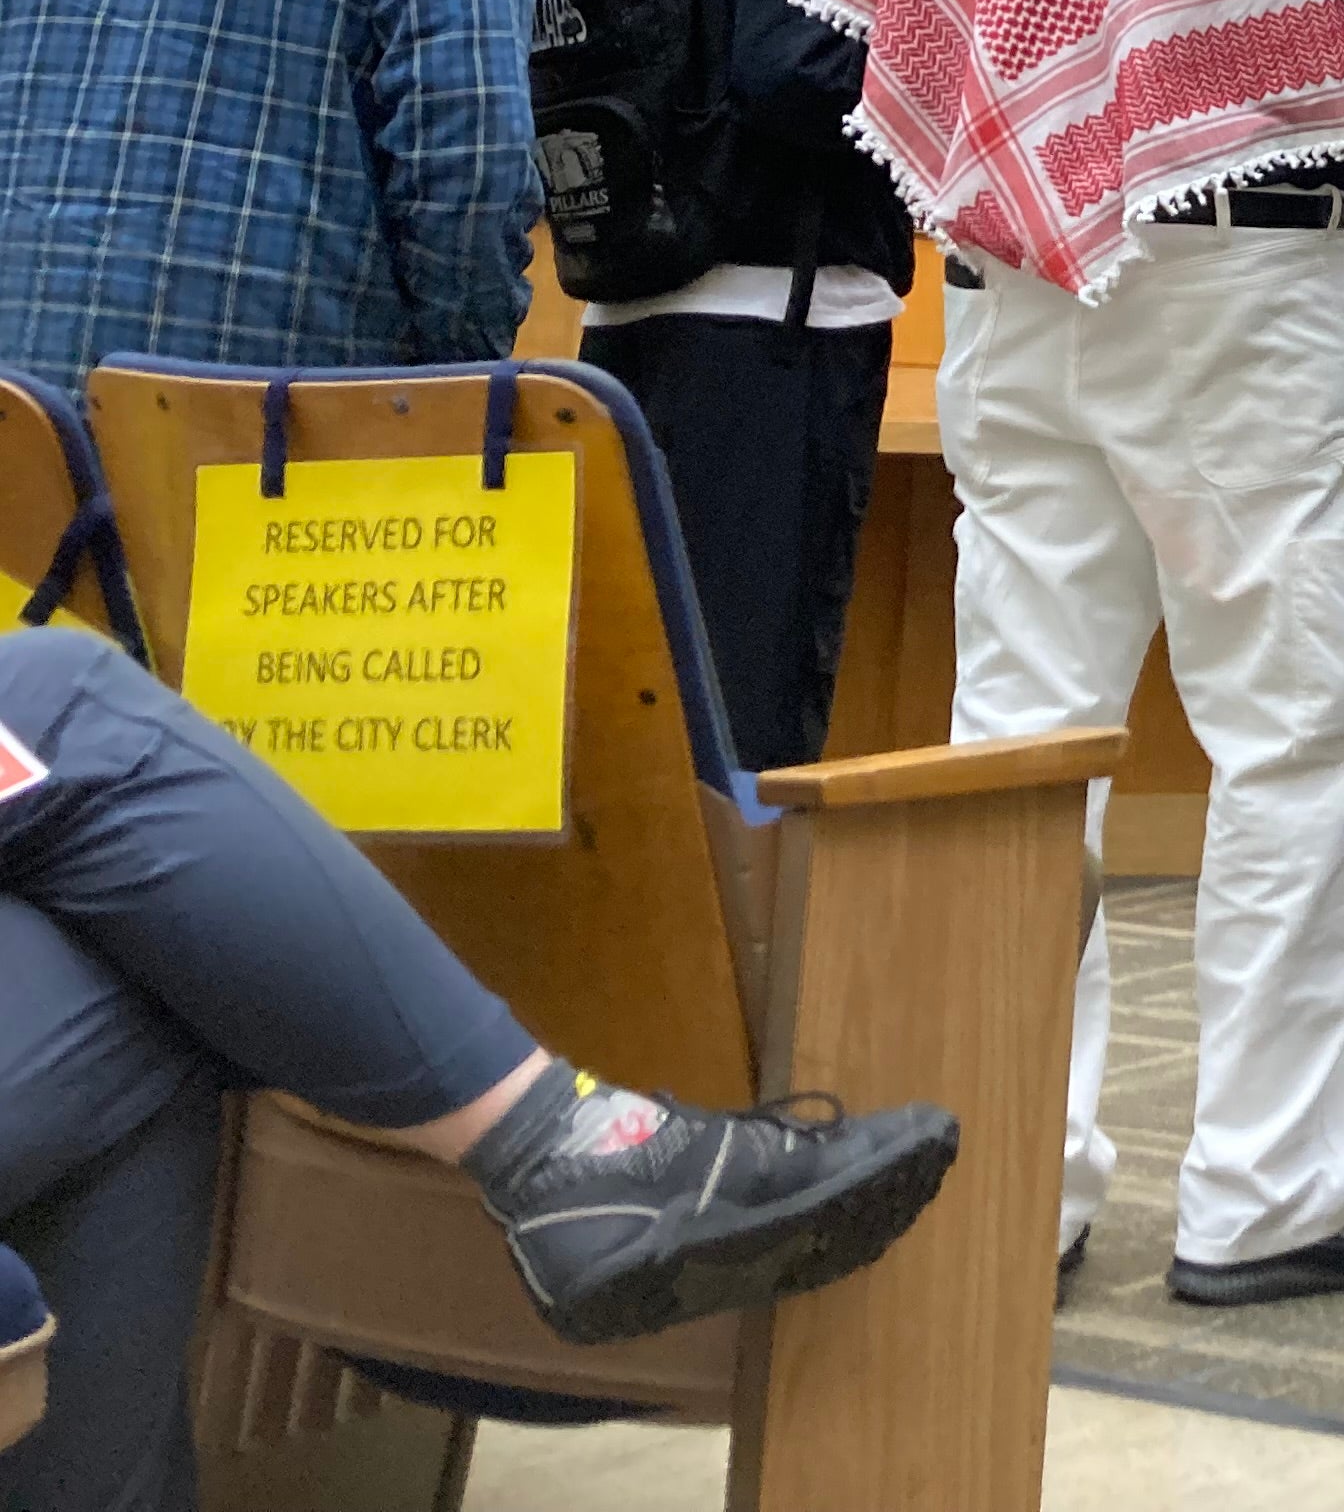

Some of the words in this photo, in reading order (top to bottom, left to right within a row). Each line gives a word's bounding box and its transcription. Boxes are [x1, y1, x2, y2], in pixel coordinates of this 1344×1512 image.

[264, 517, 422, 553] RESERVED
[433, 515, 498, 549] FOR
[243, 581, 396, 616] SPEAKERS
[406, 578, 507, 611] AFTER
[256, 649, 351, 683] BEING
[362, 647, 481, 682] CALLED
[267, 717, 326, 752] THE
[337, 717, 404, 751] CITY
[414, 716, 513, 751] CLERK
